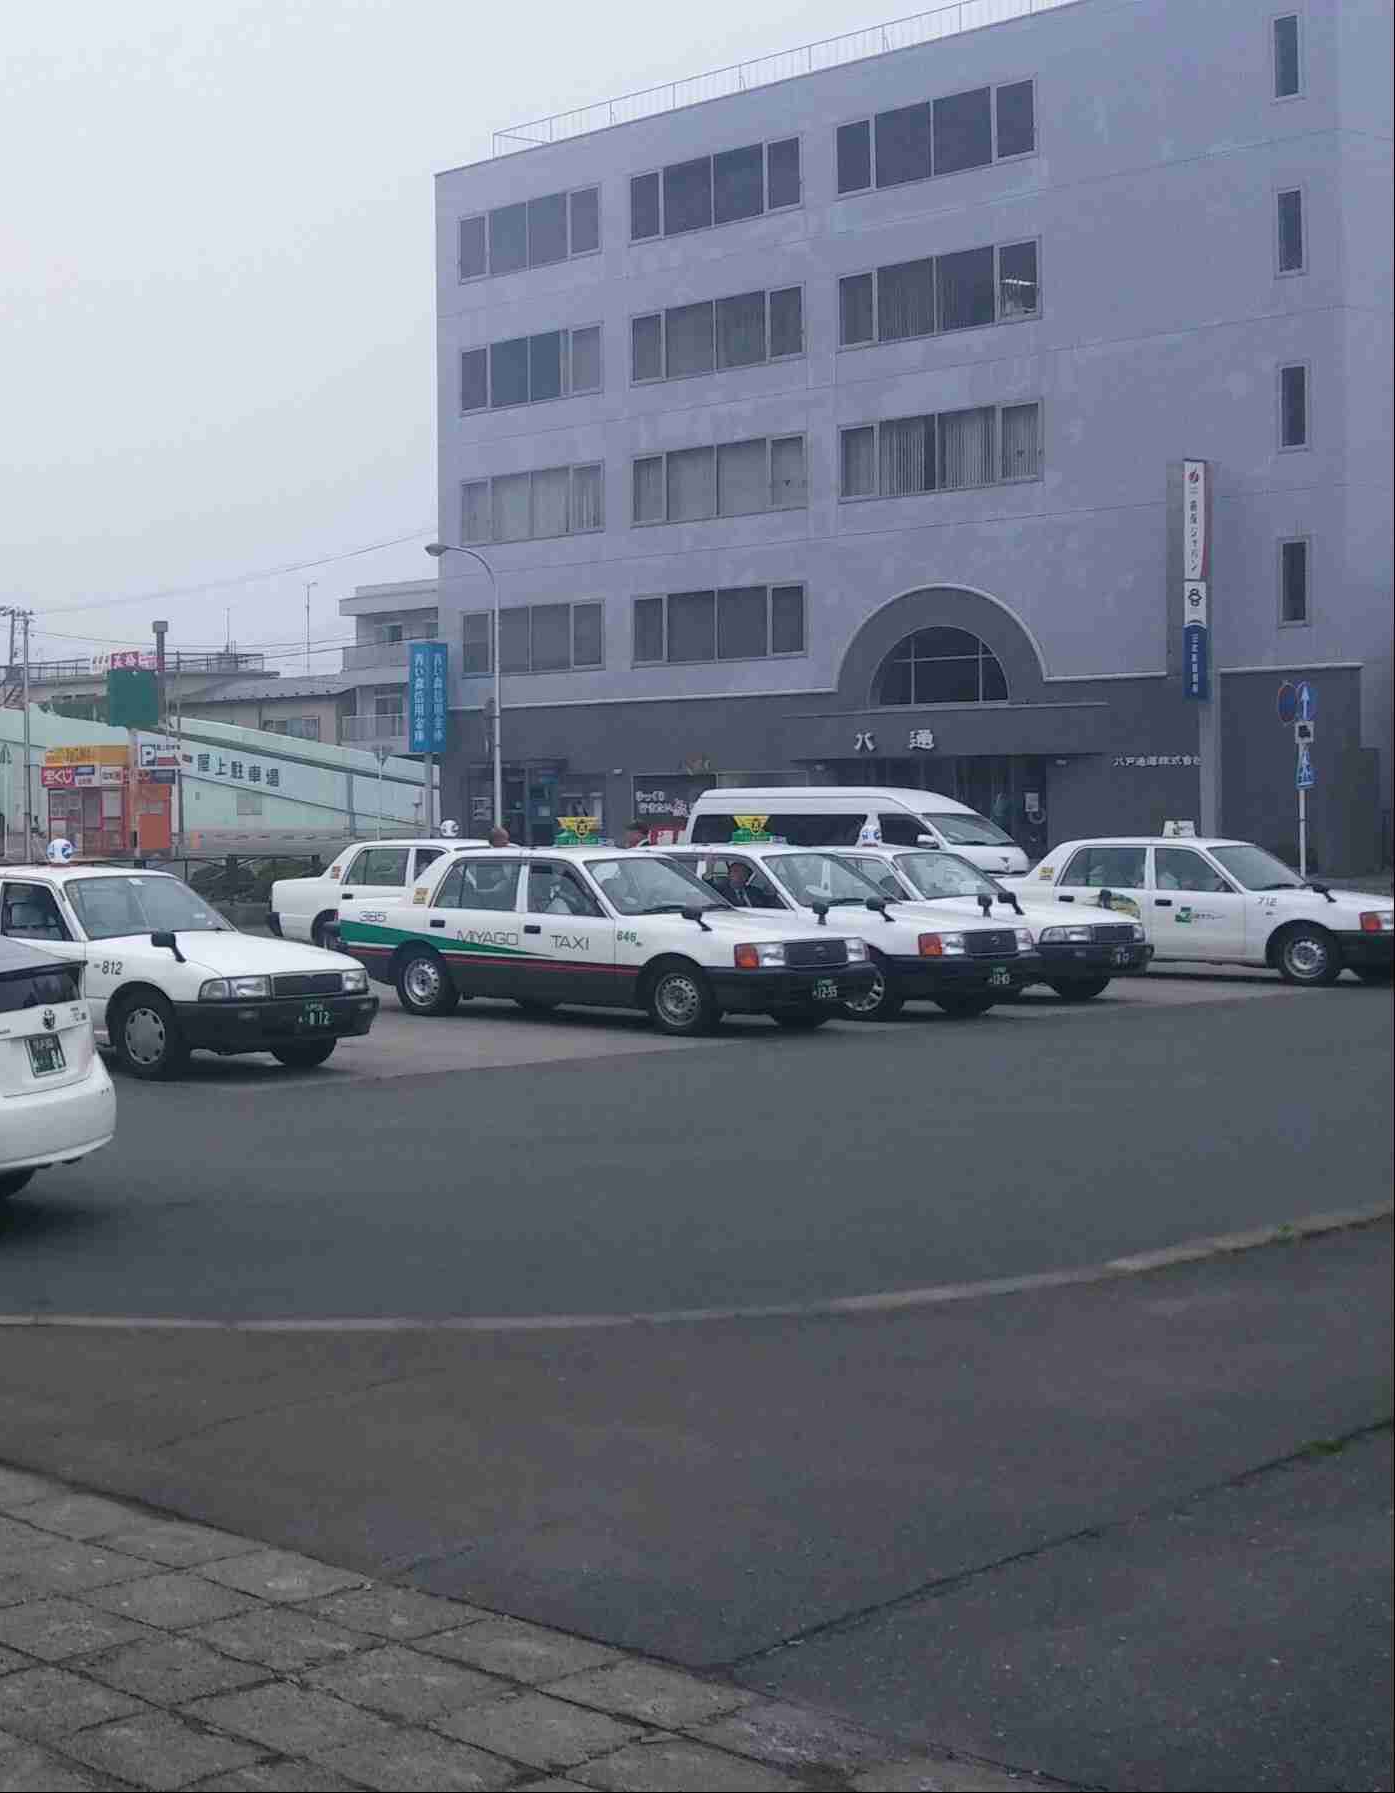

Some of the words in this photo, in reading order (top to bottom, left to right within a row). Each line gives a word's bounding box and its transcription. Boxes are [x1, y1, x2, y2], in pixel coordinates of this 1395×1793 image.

[197, 753, 280, 786] 屋上駐車場
[456, 929, 519, 946] MIYAGO
[550, 934, 589, 950] TAXI
[102, 960, 123, 975] 812
